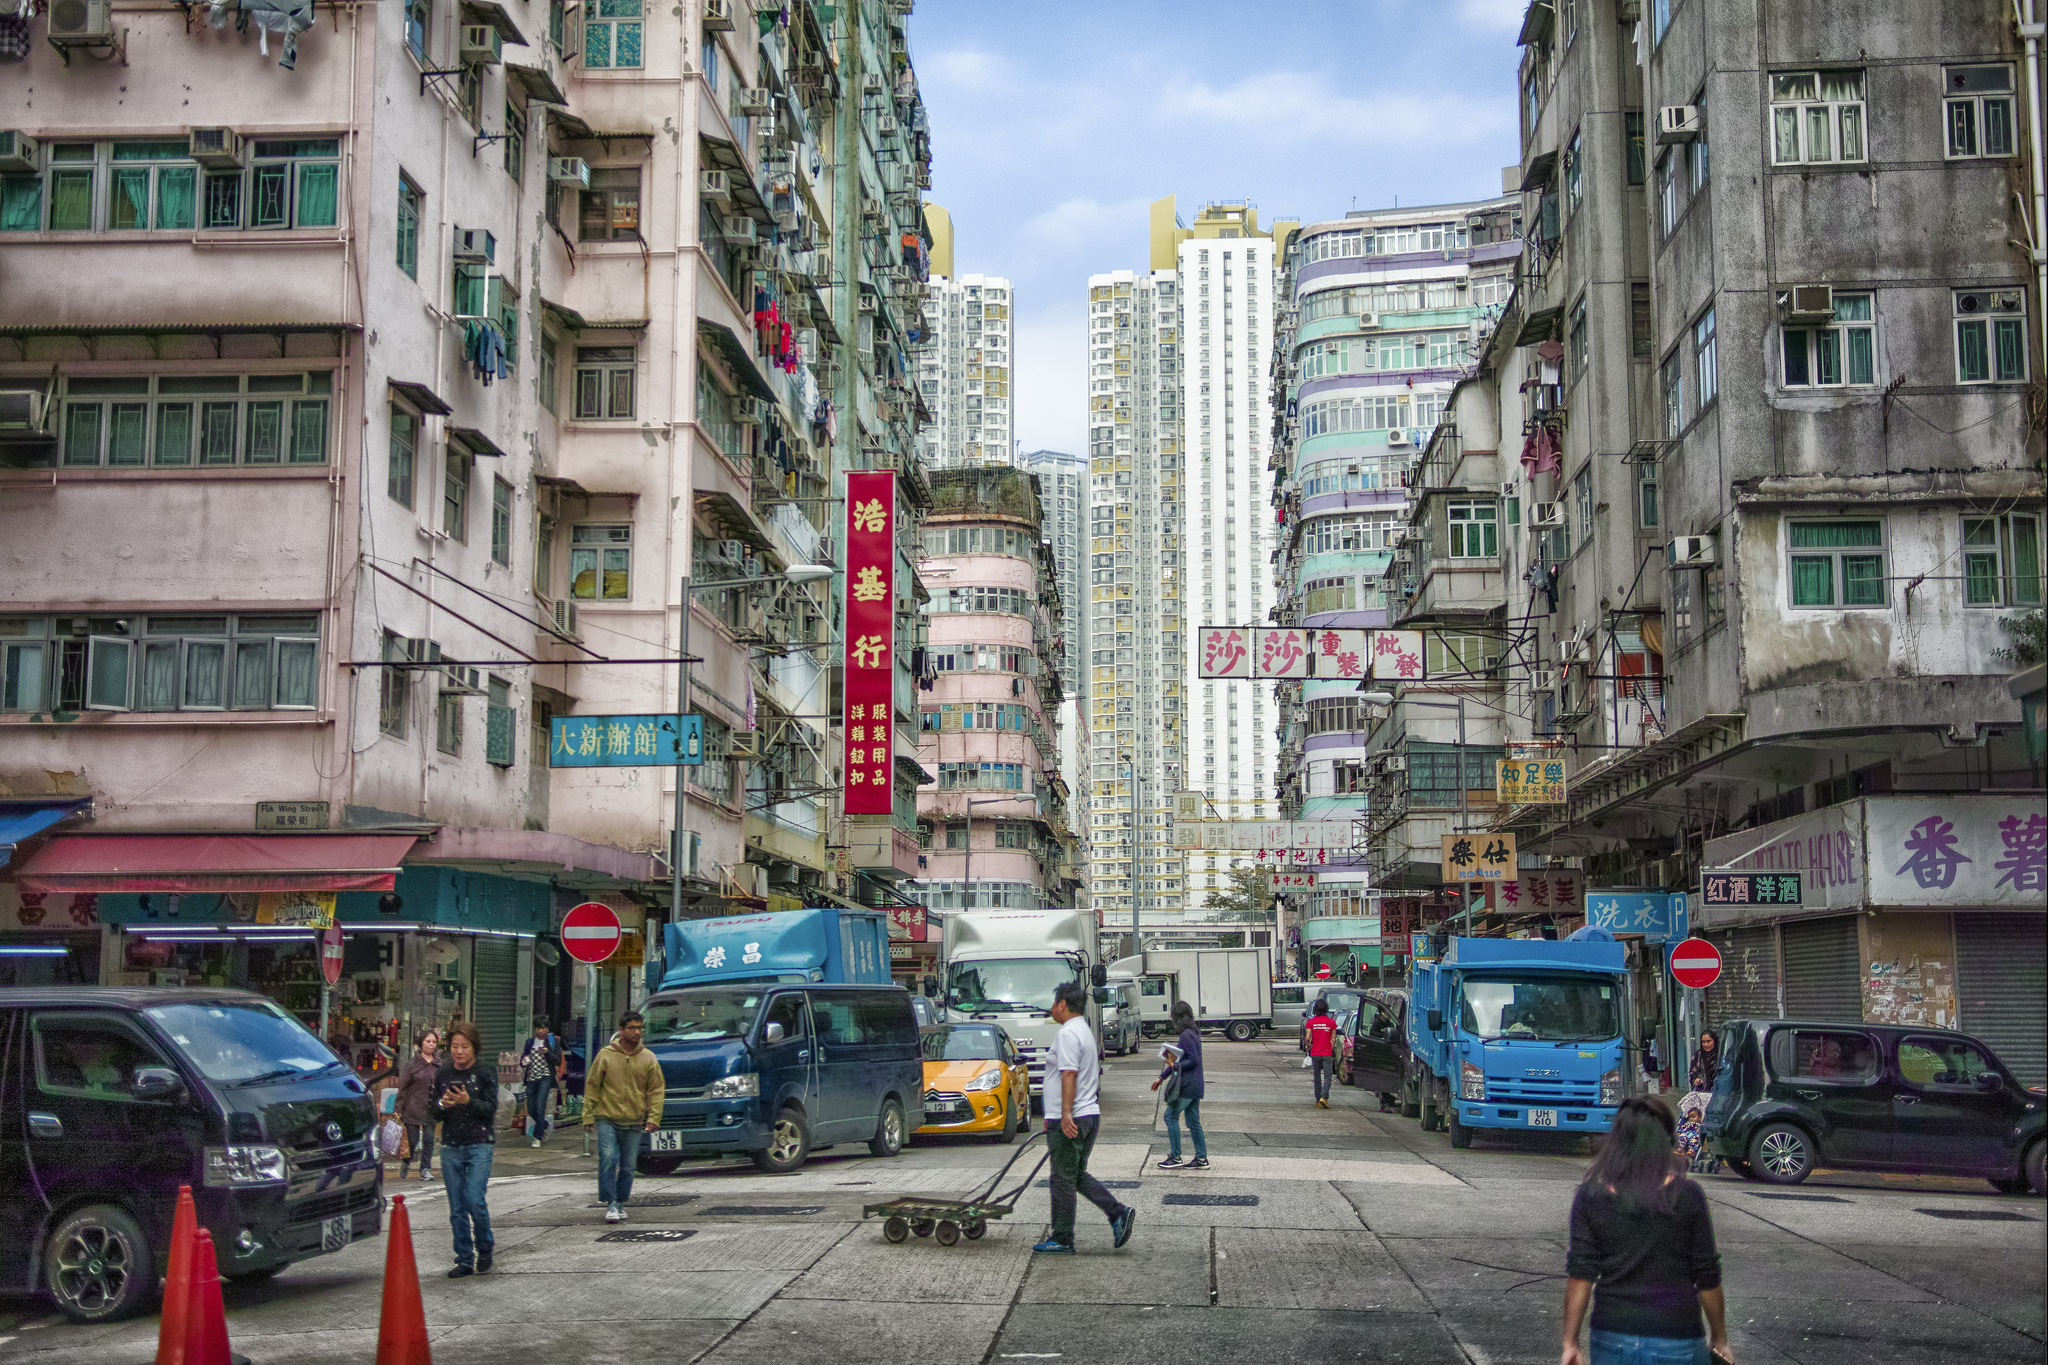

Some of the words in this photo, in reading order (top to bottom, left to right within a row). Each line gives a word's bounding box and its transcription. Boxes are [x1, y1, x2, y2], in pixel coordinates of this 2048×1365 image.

[851, 498, 888, 669] 浩基行
[1501, 762, 1564, 785] 知足樂
[261, 804, 274, 812] Fuk
[278, 805, 297, 813] Wing
[299, 804, 324, 812] Street
[276, 815, 308, 826] 福榮街
[1594, 898, 1665, 928] 洗衣
[705, 917, 773, 928] ISUZU
[703, 941, 762, 969] 榮昌
[1525, 1068, 1560, 1077] ISUZU
[934, 1103, 946, 1111] 121
[1535, 1110, 1550, 1118] UH
[1534, 1117, 1552, 1126] 610
[658, 1131, 674, 1140] LM
[656, 1139, 677, 1150] 136
